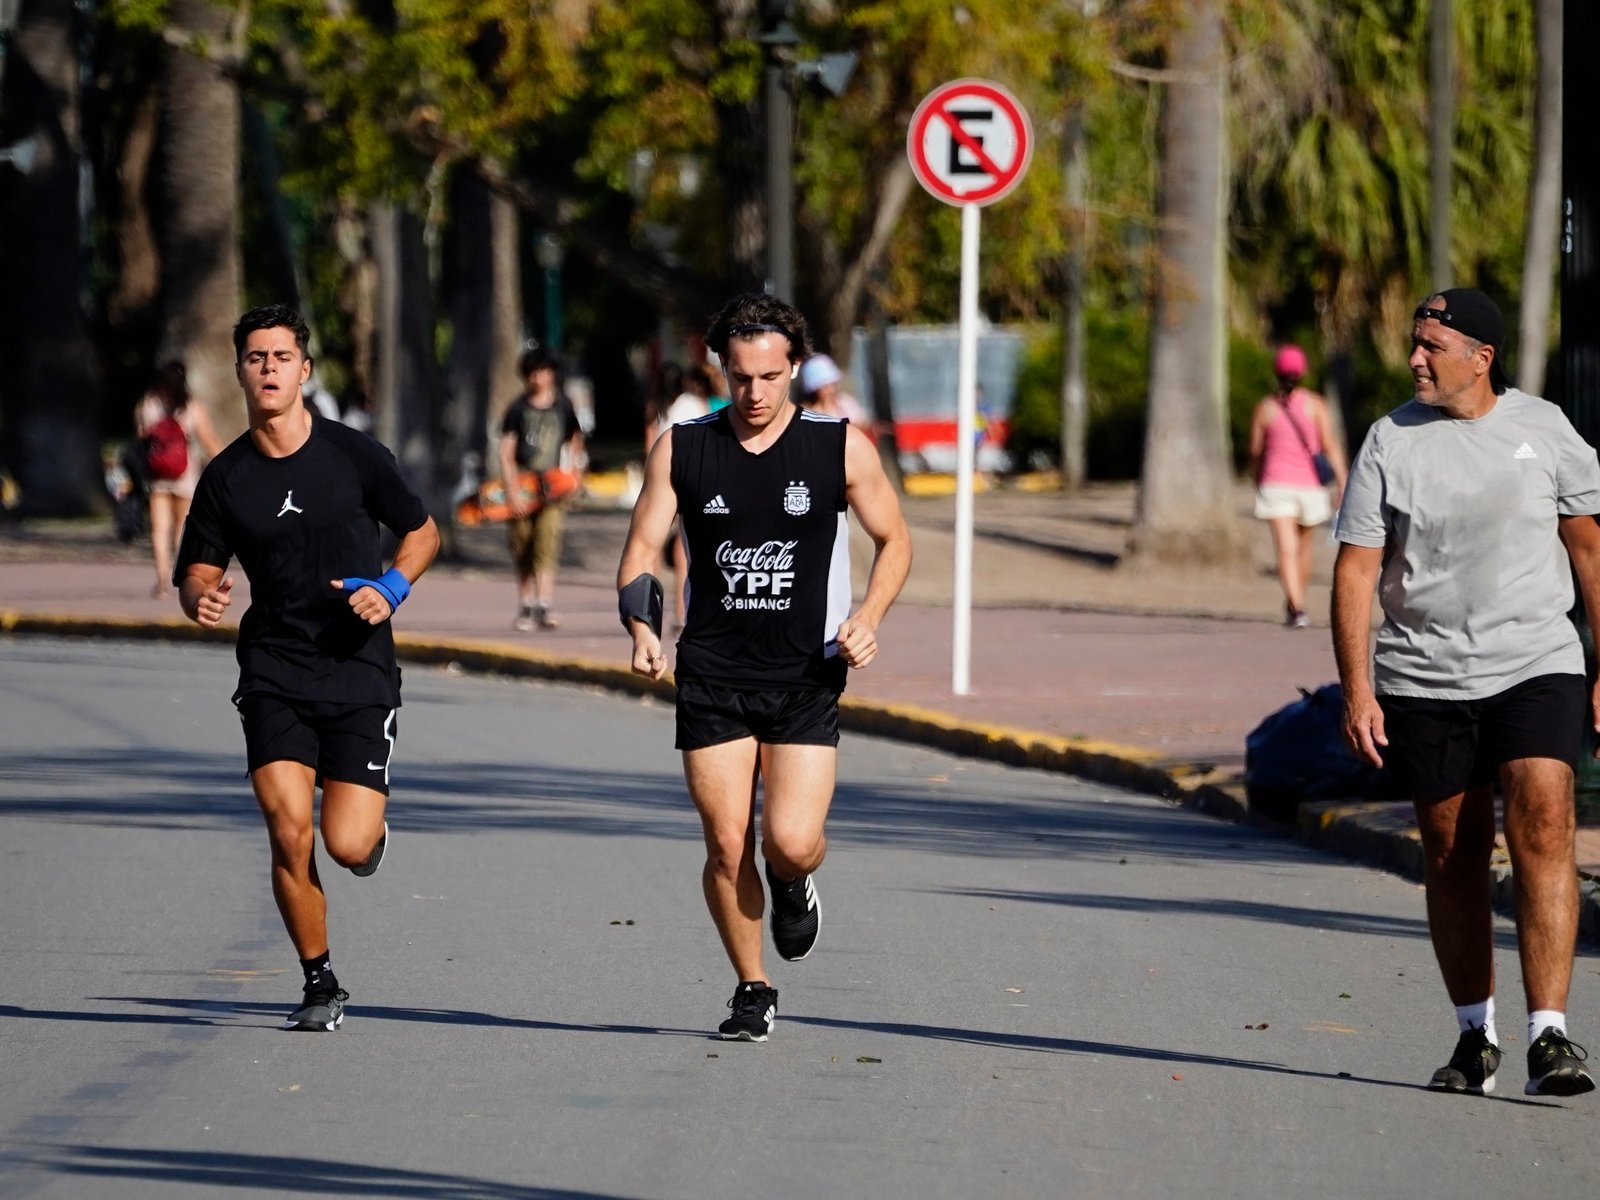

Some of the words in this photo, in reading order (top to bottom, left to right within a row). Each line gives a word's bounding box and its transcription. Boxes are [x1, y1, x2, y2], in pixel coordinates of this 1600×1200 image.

[949, 111, 993, 174] E
[715, 540, 799, 571] Coca-Cola
[721, 570, 795, 595] YPF
[735, 597, 791, 611] BINANCE
